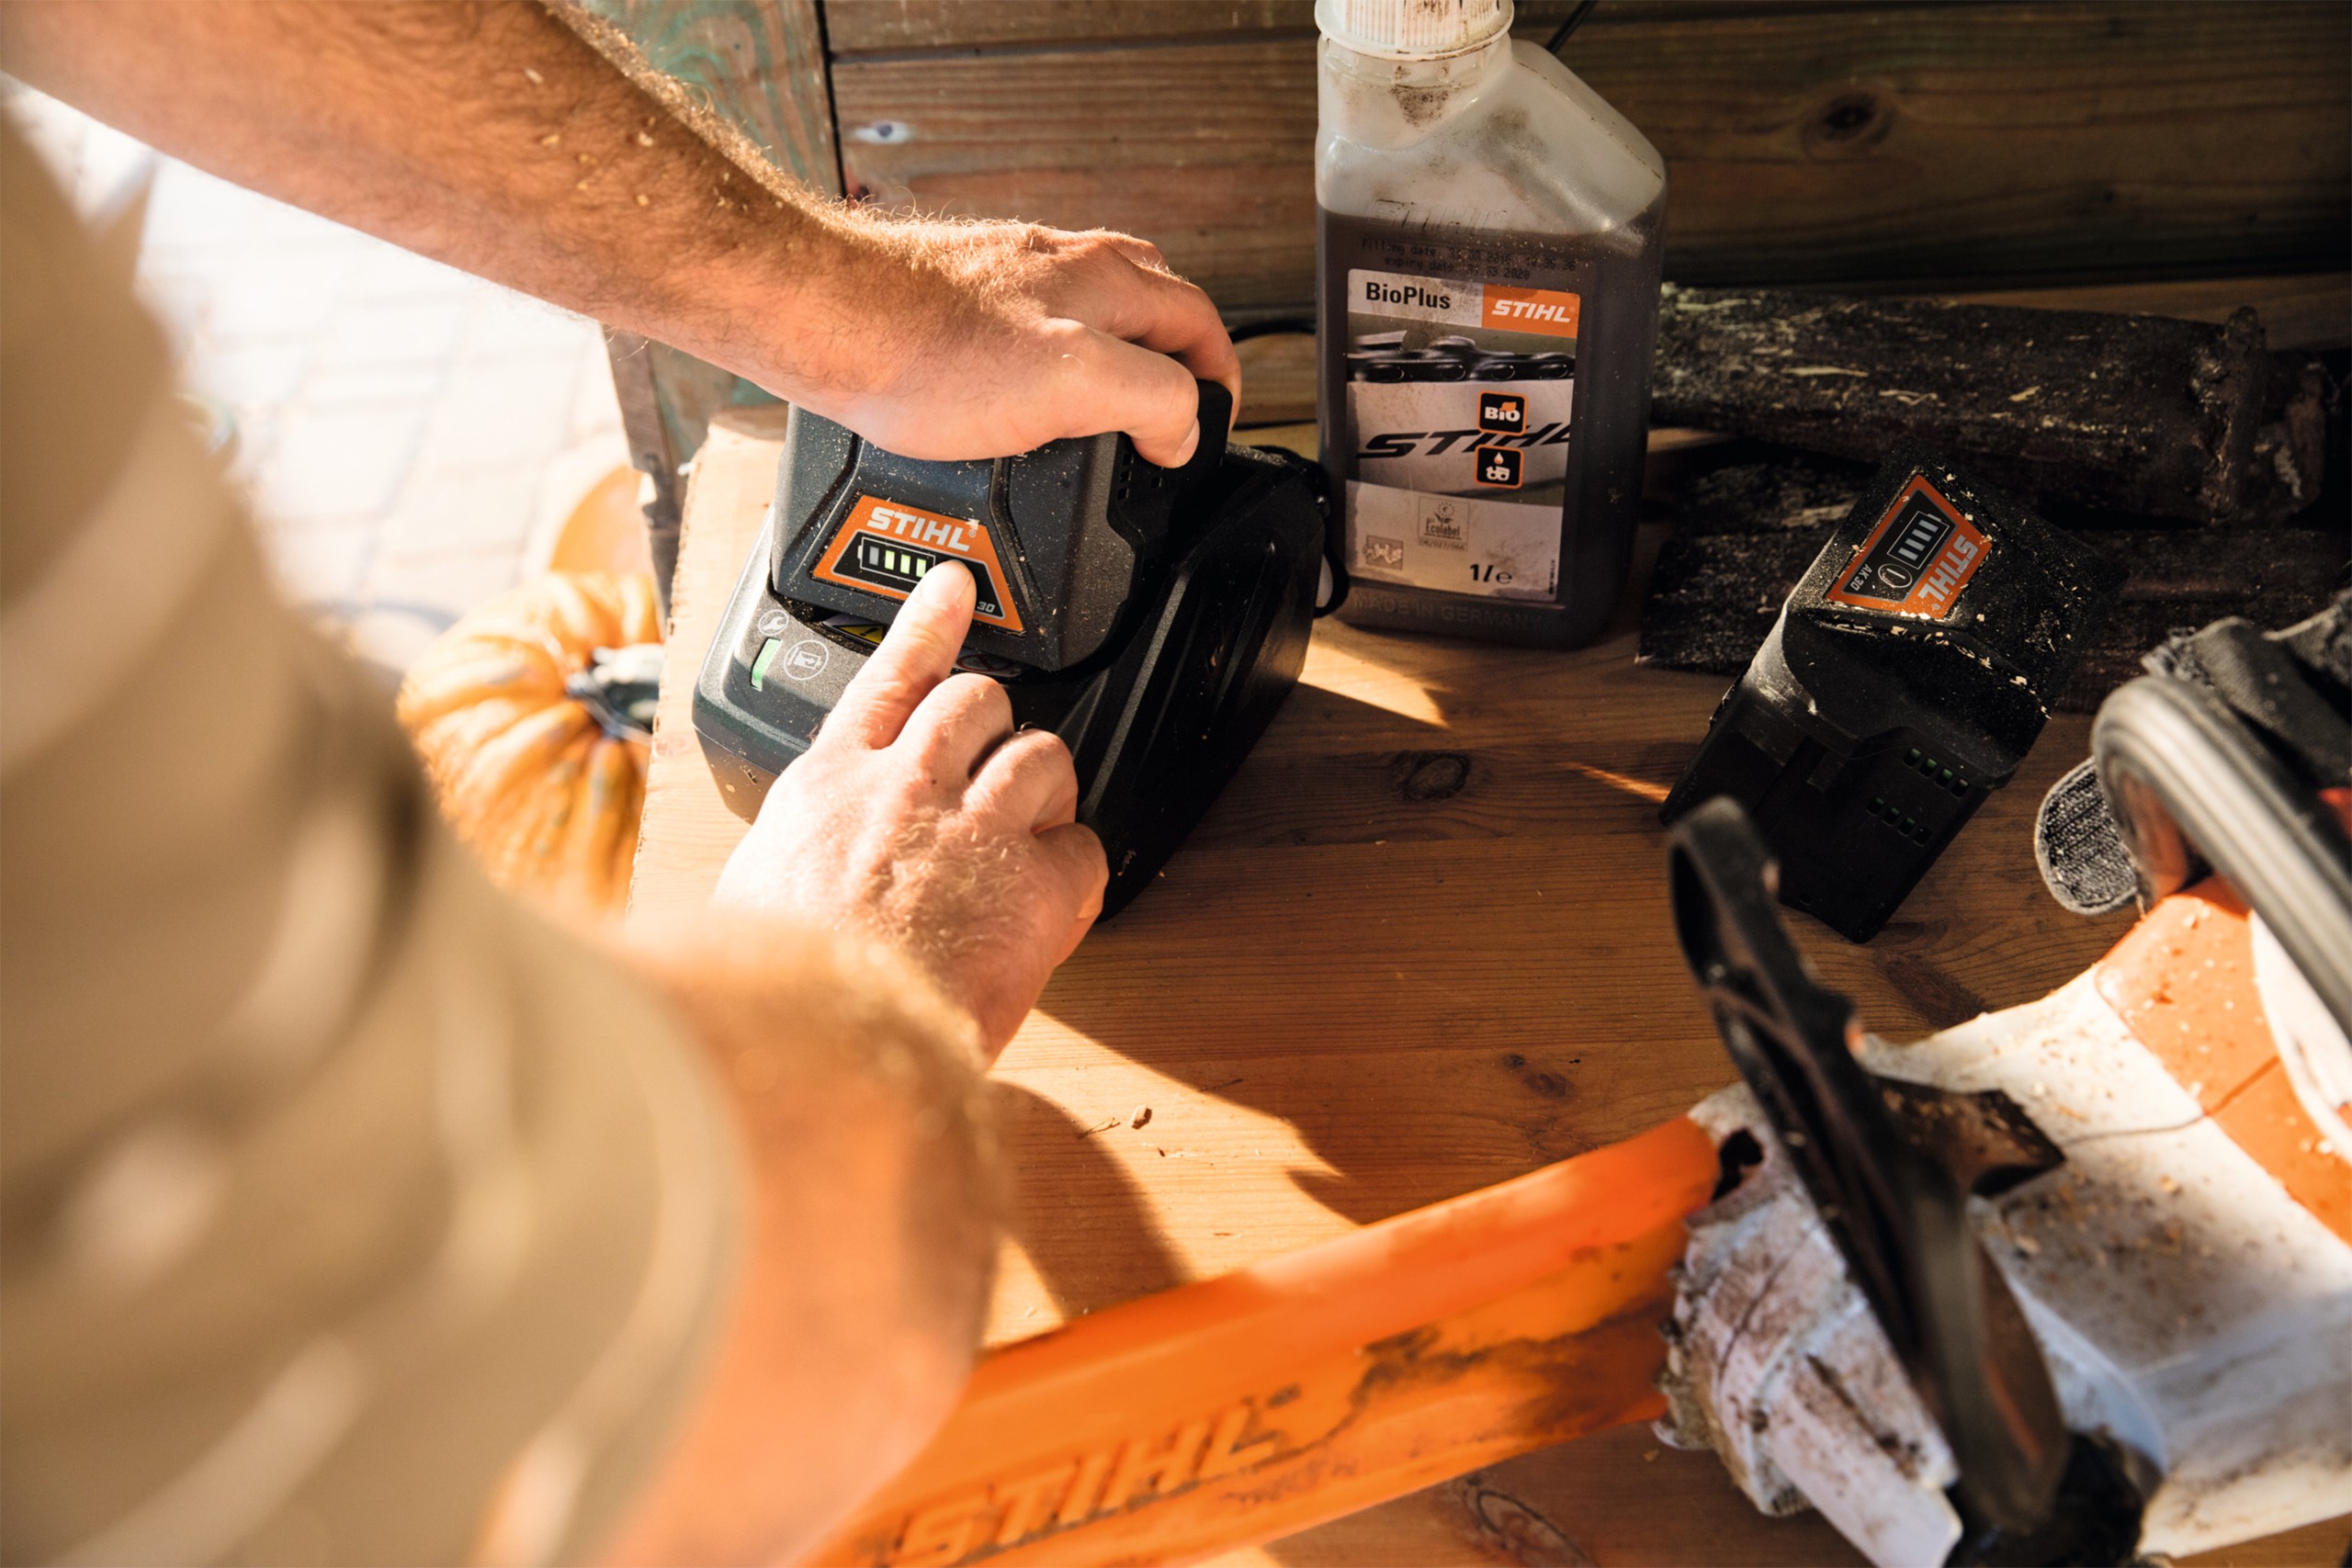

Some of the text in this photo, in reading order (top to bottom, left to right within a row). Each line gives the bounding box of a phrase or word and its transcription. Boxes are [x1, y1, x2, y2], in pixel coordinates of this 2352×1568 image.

[1365, 281, 1452, 310] BioPlus
[1491, 299, 1572, 323] STIHL
[866, 506, 971, 552] STIHL
[1917, 535, 1979, 603] STIHL
[977, 601, 996, 613] 30
[1353, 596, 1410, 616] MADE
[888, 1402, 1282, 1567] STIHL
